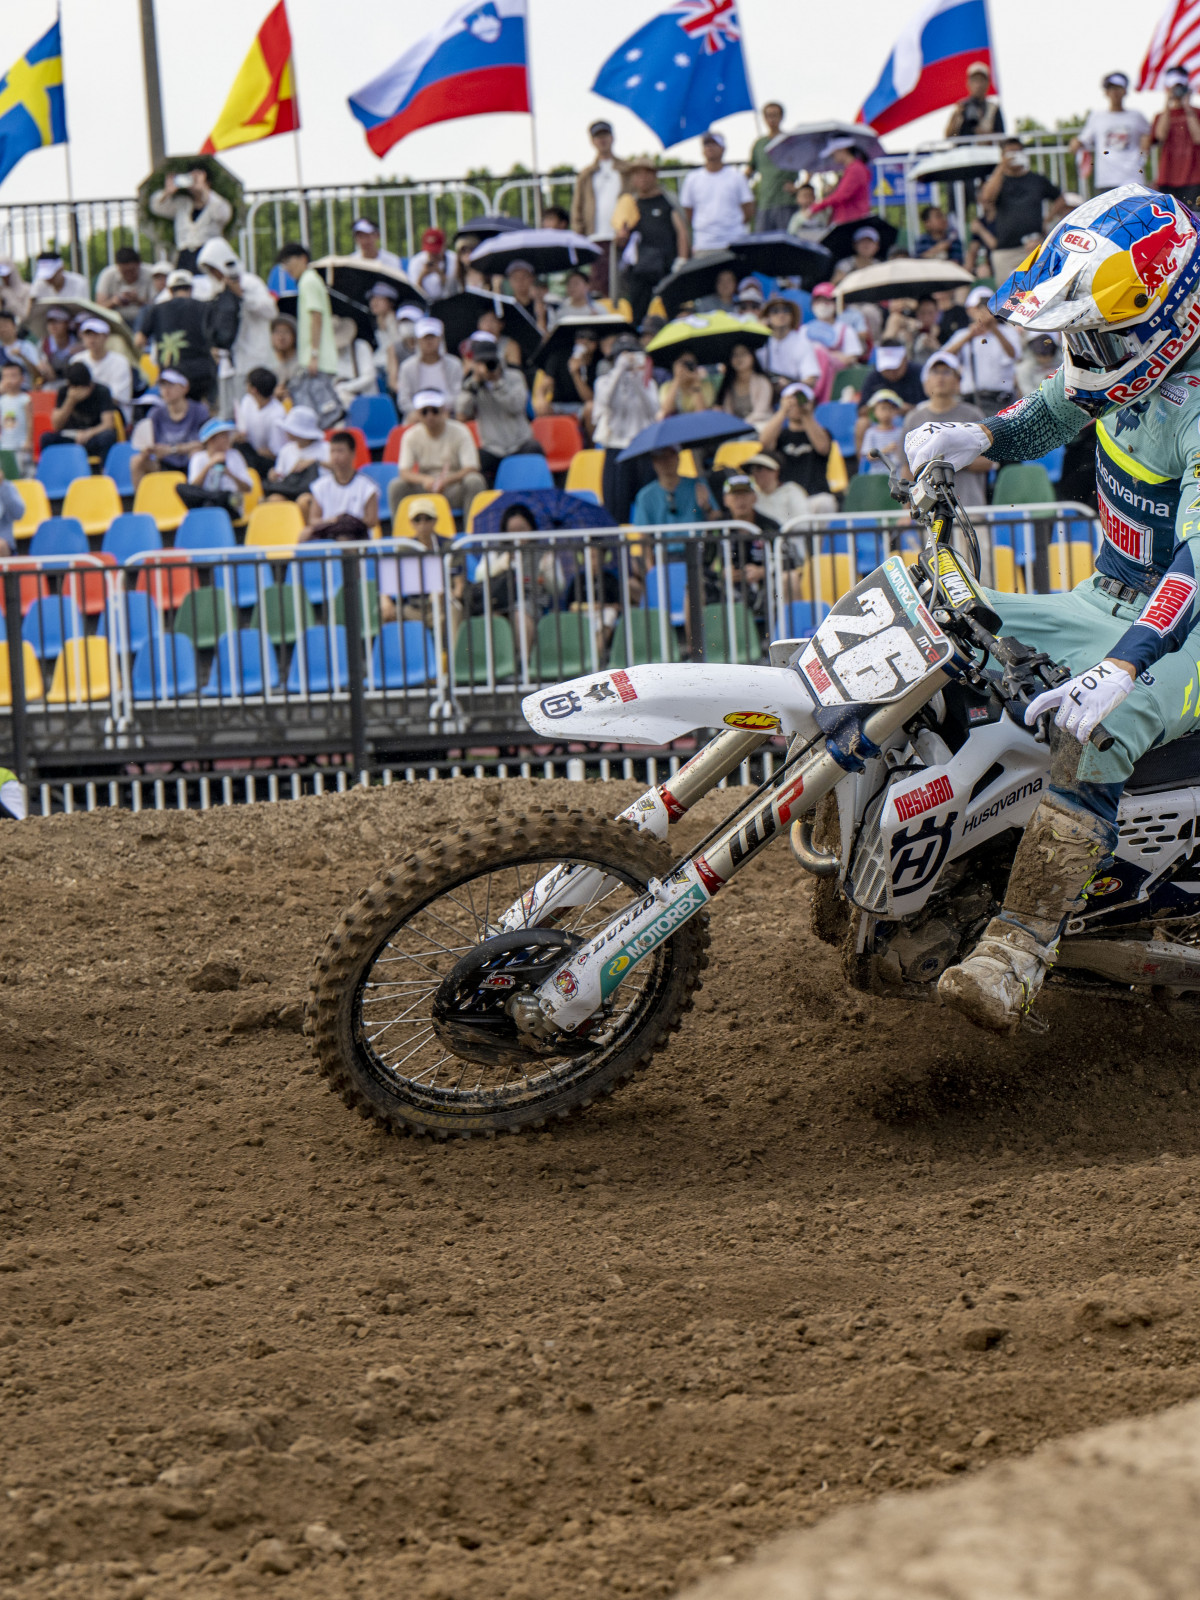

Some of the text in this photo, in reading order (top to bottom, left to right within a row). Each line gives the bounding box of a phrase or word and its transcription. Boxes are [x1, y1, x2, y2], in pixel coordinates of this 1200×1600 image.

[1064, 234, 1090, 250] BELL
[889, 567, 917, 609] MOTOREX
[816, 588, 928, 700] 26
[916, 635, 941, 663] MX2
[1069, 665, 1112, 706] FOX
[726, 713, 781, 730] FMF
[893, 774, 954, 822] nestaan
[962, 777, 1043, 836] Husqvarna
[591, 894, 656, 955] DUNLO
[626, 889, 700, 960] MOTOREX
